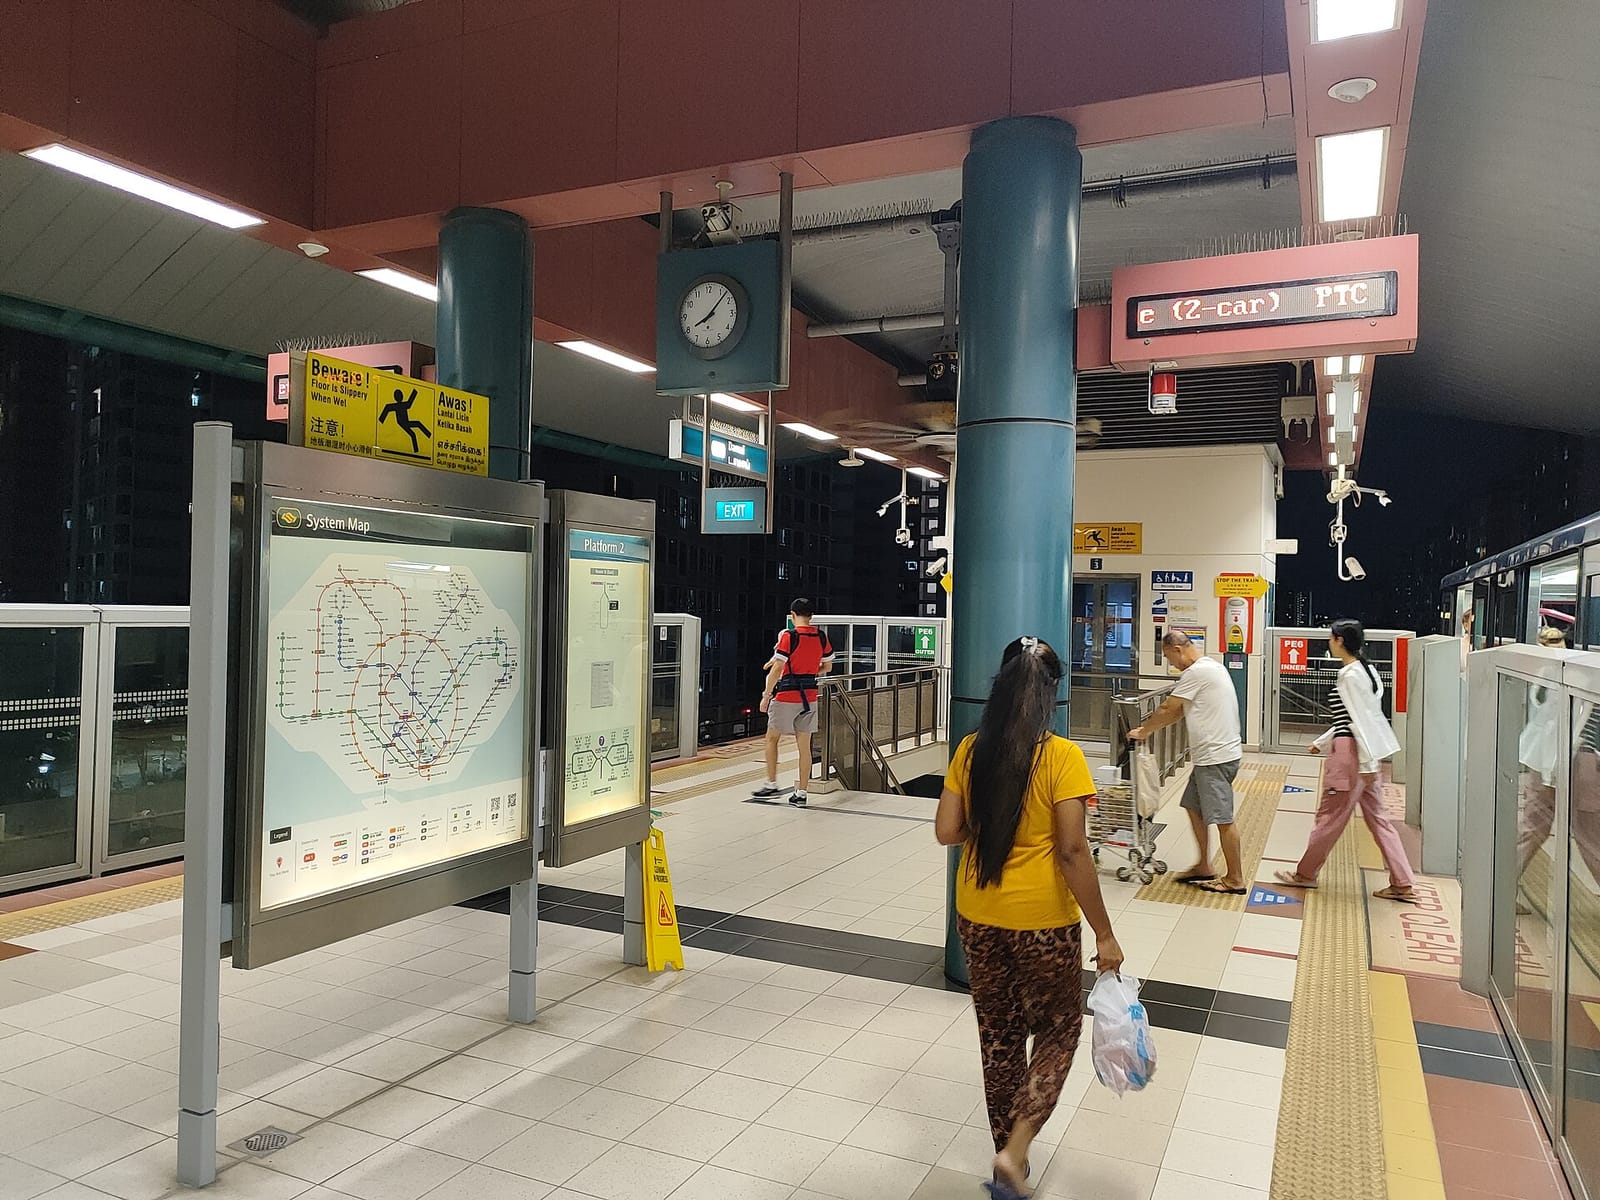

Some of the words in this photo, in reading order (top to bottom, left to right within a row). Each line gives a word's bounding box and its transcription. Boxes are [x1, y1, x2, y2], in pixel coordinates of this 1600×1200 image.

[1172, 292, 1280, 322] (2-car)
[1314, 282, 1368, 308] PTC
[312, 378, 330, 390] Floor
[340, 385, 368, 401] Slippery
[311, 392, 331, 404] When
[334, 396, 346, 407] Wet
[438, 408, 454, 419] Lantai
[456, 412, 470, 422] Licin
[437, 419, 454, 430] Ketika
[456, 423, 472, 433] Basah
[724, 504, 746, 518] EXIT
[306, 514, 345, 531] System
[348, 517, 370, 534] Map
[584, 538, 618, 553] Platform
[620, 542, 625, 554] 2
[1400, 913, 1462, 966] CLEAR
